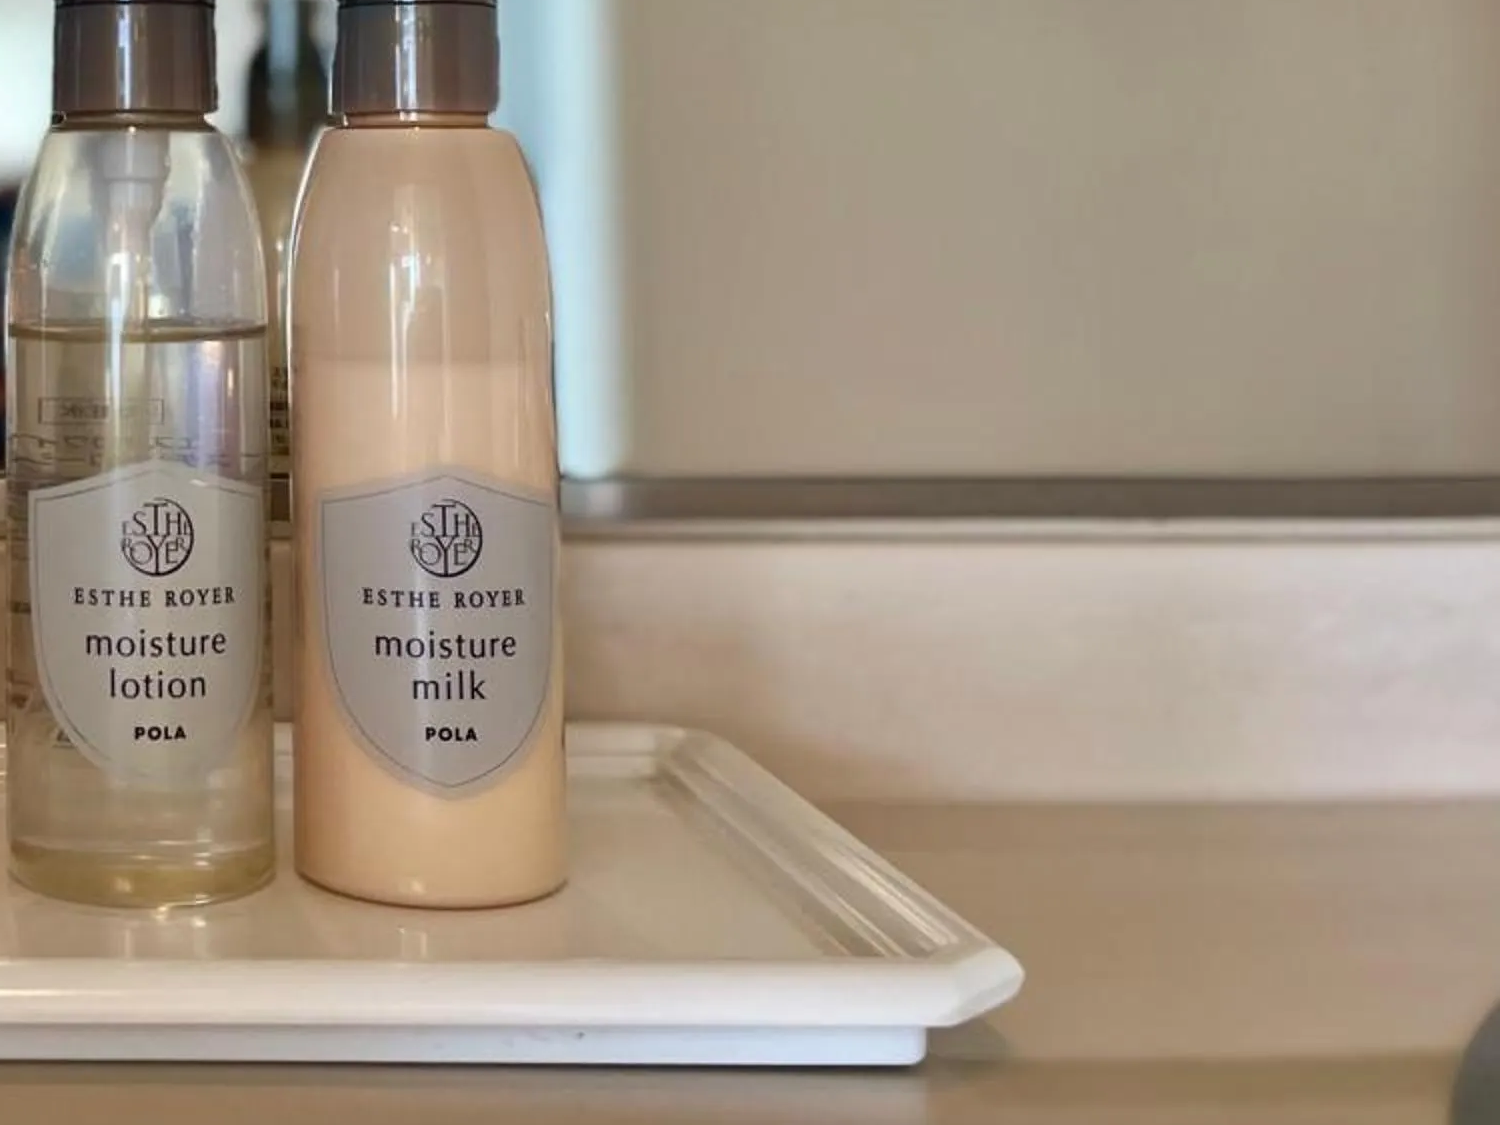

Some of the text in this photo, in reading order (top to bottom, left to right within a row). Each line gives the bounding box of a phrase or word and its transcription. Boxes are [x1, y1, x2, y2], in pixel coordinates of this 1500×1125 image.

[73, 586, 235, 608] ESTHE ROYER
[362, 587, 526, 610] ESTHE ROYER
[85, 628, 227, 659] moisture
[374, 630, 517, 660] moisture
[109, 667, 207, 700] lotion
[412, 668, 487, 701] milk
[133, 724, 187, 742] POLA
[424, 726, 479, 743] POLA
